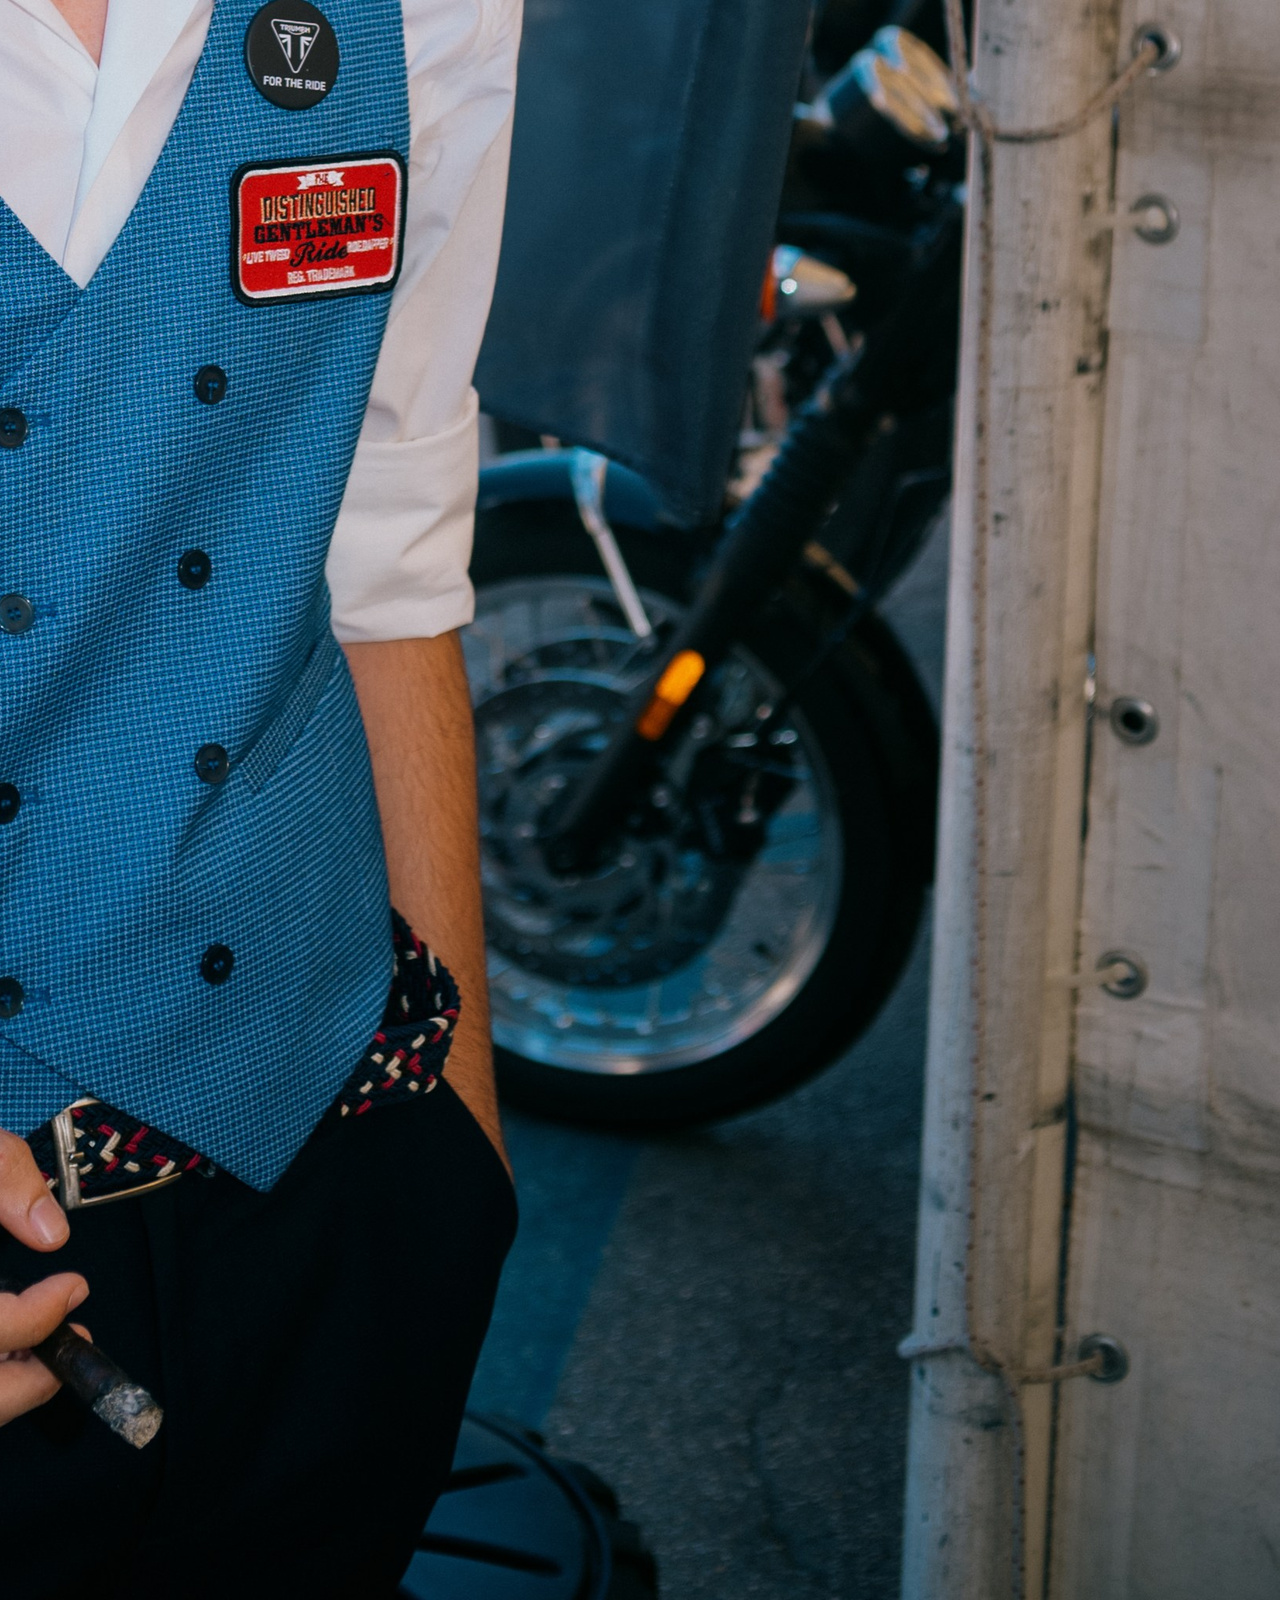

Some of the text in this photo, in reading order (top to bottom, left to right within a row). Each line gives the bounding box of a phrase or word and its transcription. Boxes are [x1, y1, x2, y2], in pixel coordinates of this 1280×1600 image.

[280, 24, 311, 34] TRIUMPH
[263, 75, 326, 91] FOR THE RIDE
[260, 187, 376, 224] DISTINGUISHED
[254, 213, 384, 244] GENTLEMAN'S
[290, 240, 350, 268] Ride
